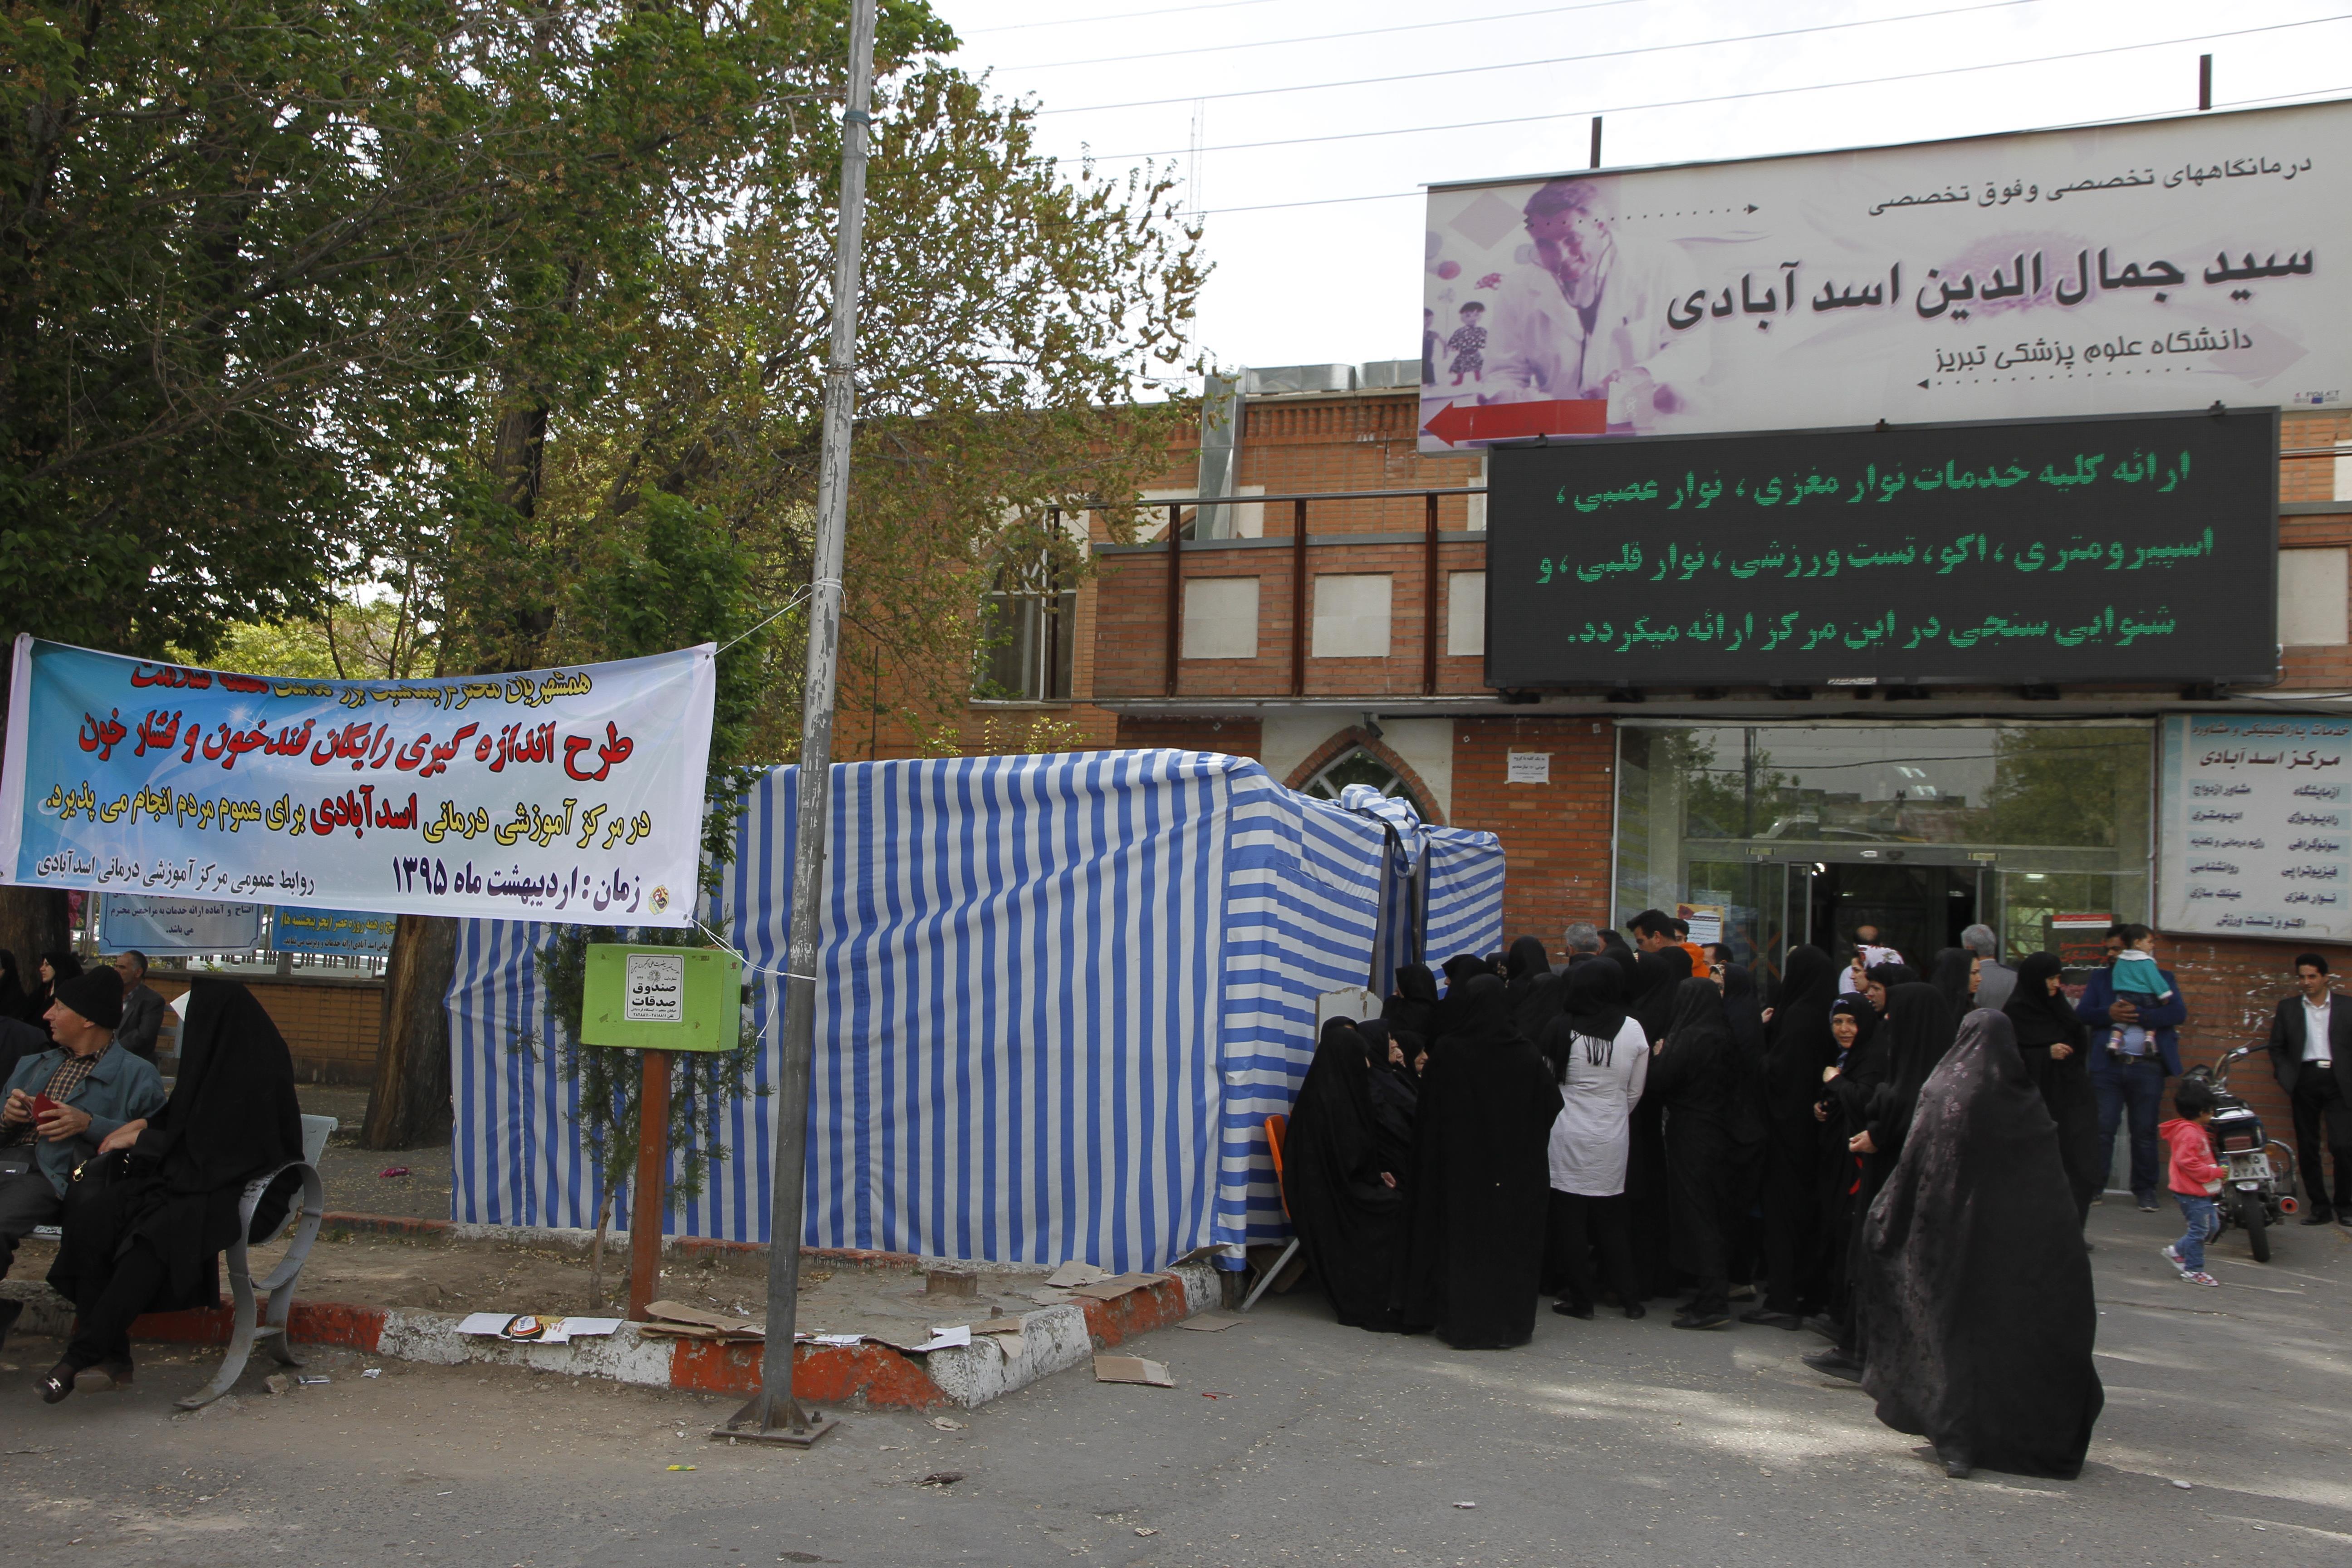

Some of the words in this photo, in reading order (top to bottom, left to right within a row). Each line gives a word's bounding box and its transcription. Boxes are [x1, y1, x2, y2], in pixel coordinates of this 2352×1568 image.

[2046, 168, 2154, 201] تخصصی
[2164, 156, 2312, 188] درمانگاههای
[1869, 183, 1970, 216] تخصصی
[1978, 179, 2022, 207] فوق
[2027, 185, 2038, 202] و
[1813, 260, 1901, 312] اسد
[1917, 250, 2041, 319] الدین
[2056, 246, 2184, 306] جمال
[2203, 246, 2313, 300] سید
[1667, 260, 1799, 331] آبادی
[1994, 338, 2074, 369] پزشکی
[2084, 336, 2141, 363] علوم
[2151, 327, 2252, 355] دانشگاه
[1936, 345, 1987, 372] تبریز
[1846, 461, 1906, 502] نوار
[1913, 458, 2030, 490] خدمات
[2038, 453, 2105, 493] کلیه
[2112, 447, 2190, 492] ارائه
[1667, 469, 1722, 510] نوار
[1650, 541, 1705, 581] نوار
[1847, 536, 1916, 568] تست
[1536, 557, 1552, 583] و
[1686, 608, 1753, 651] ارائه
[1760, 611, 1837, 650] مرکز
[1844, 609, 1896, 649] این
[1902, 617, 1941, 648] در
[1948, 612, 2049, 648] سنجی
[2054, 604, 2176, 647] شنوایی
[443, 682, 502, 710] محترم
[505, 671, 592, 708] همشهریان
[78, 707, 127, 761] خون
[134, 709, 182, 758] فشار
[181, 723, 201, 764] و
[2311, 724, 2351, 736] خدمات
[310, 721, 395, 772] رایگان
[394, 721, 480, 778] گیری
[474, 720, 557, 773] اندازه
[563, 720, 634, 782] طرح
[2200, 747, 2247, 769] آبادی
[2248, 750, 2284, 764] اسد
[2286, 750, 2341, 770] مرکز
[131, 784, 173, 824] انجام
[2293, 784, 2341, 800] آزمایشگاه
[99, 794, 129, 823] می
[176, 792, 215, 830] مردم
[218, 797, 262, 833] عموم
[265, 793, 306, 836] برای
[422, 799, 490, 844] درمانی
[495, 798, 578, 848] آموزشی
[2287, 810, 2339, 827] رادیولوژی
[576, 803, 624, 850] مرکز
[626, 809, 651, 846] در
[2288, 838, 2340, 853] سونوگرافی
[98, 857, 140, 884] درمانی
[143, 858, 195, 889] آموزشی
[198, 861, 228, 891] مرکز
[230, 875, 275, 896] عمومی
[279, 870, 315, 896] روابط
[392, 855, 448, 897] ۱۳۹۵
[454, 859, 482, 896] ماه
[486, 864, 579, 910] اردیبهشت
[2284, 891, 2309, 904] مغزی
[2309, 892, 2337, 905] نوار
[110, 906, 131, 917] محترم
[132, 906, 158, 917] مراجعین
[159, 908, 165, 916] به
[165, 906, 187, 916] خدمات
[188, 904, 204, 917] ارائه
[206, 904, 225, 915] آماده
[227, 909, 231, 917] و
[332, 918, 348, 932] عصر
[348, 917, 365, 934] روزه
[366, 918, 378, 930] همه
[2245, 916, 2274, 925] تست
[184, 927, 194, 936] می
[632, 983, 676, 995] صندوق
[632, 995, 676, 1007] صدقات
